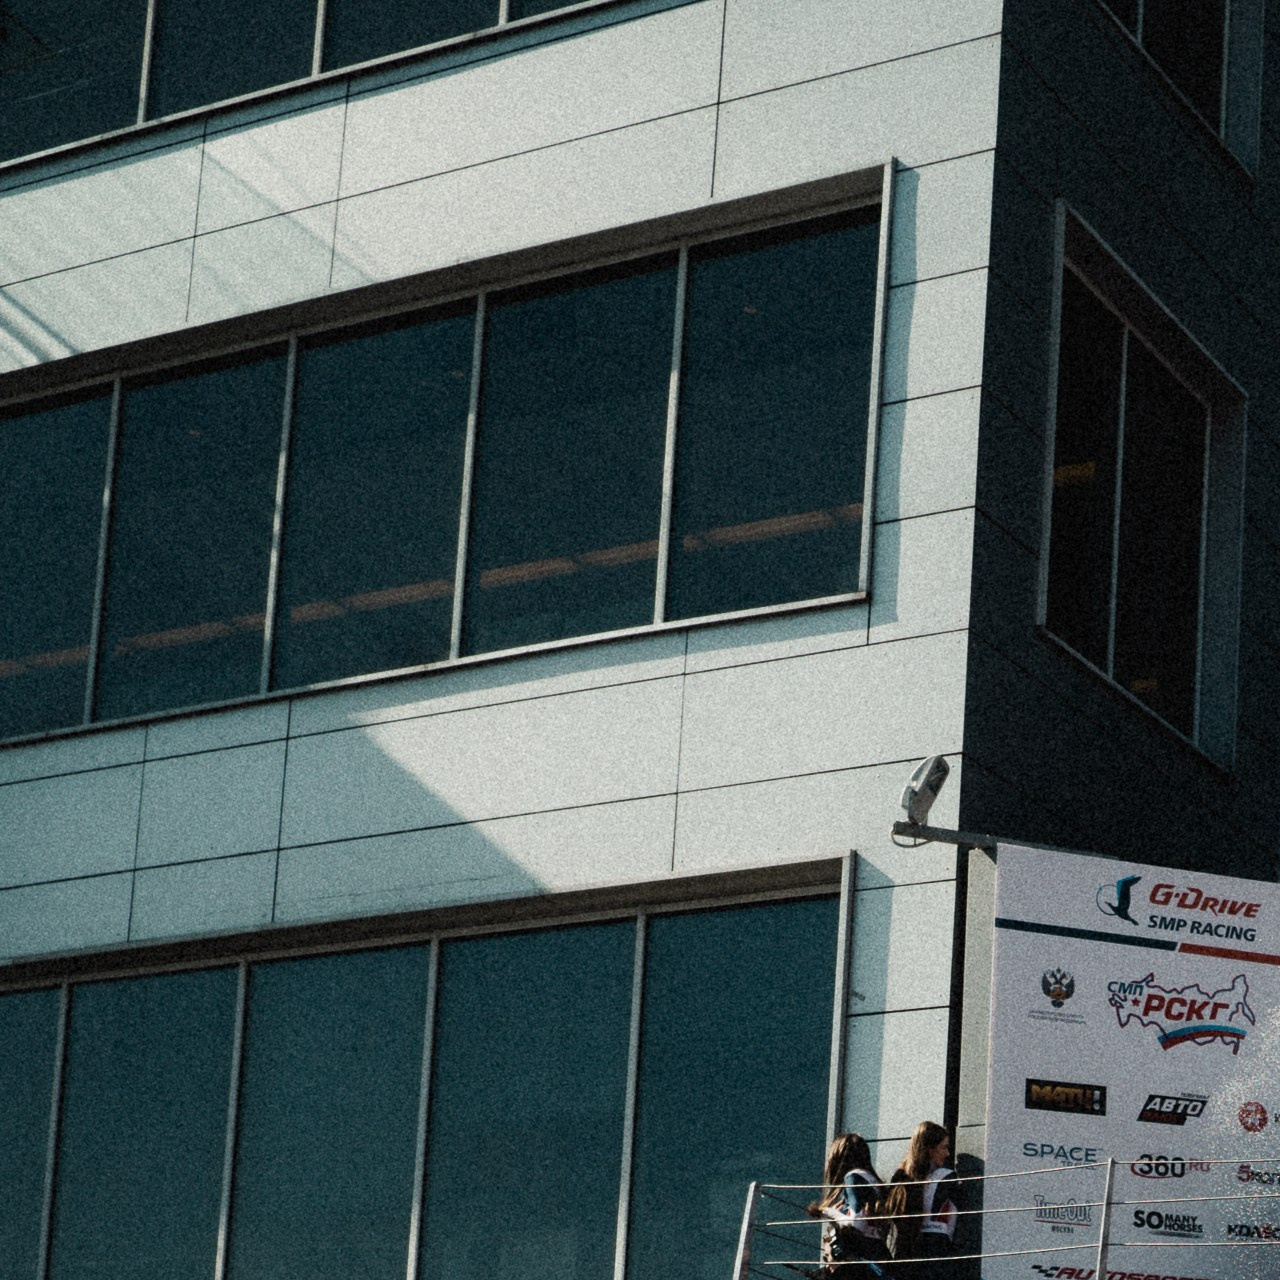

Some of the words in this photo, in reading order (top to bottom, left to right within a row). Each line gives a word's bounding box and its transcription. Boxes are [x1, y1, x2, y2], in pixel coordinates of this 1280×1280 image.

[1148, 915, 1187, 931] SMP
[1190, 920, 1256, 941] RACING
[1107, 981, 1145, 996] СМП
[1142, 994, 1229, 1021] РСКГ
[1146, 1098, 1203, 1117] АВТО
[1022, 1142, 1099, 1164] SPACE
[1133, 1209, 1163, 1230] SO
[1164, 1213, 1197, 1225] MANY
[1164, 1222, 1203, 1234] HORSES
